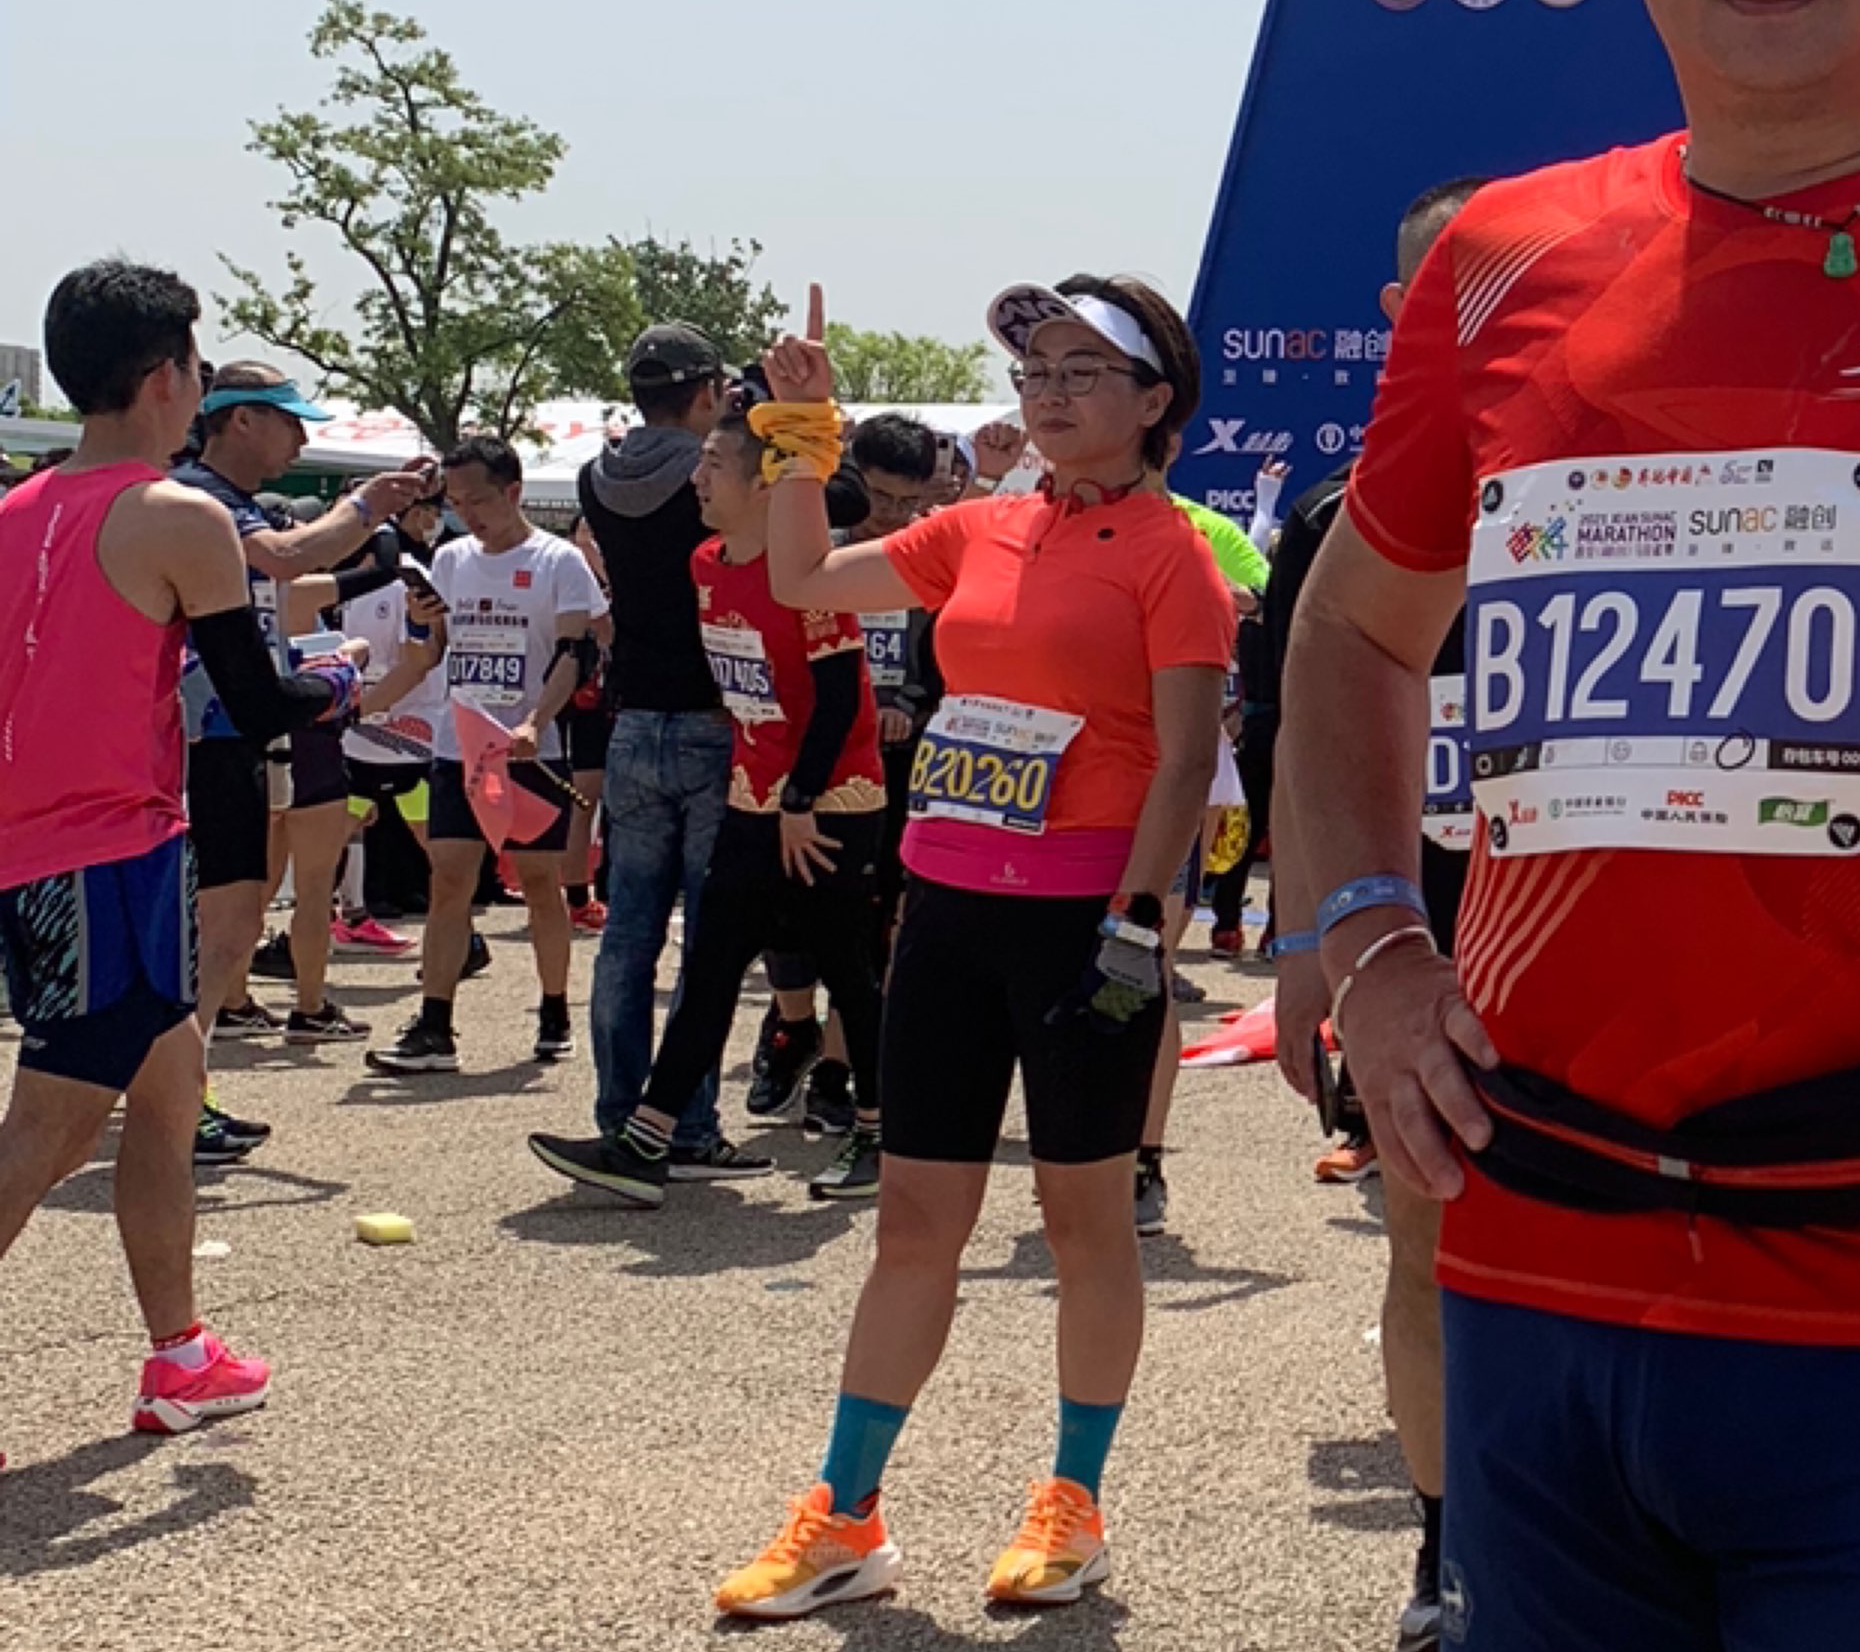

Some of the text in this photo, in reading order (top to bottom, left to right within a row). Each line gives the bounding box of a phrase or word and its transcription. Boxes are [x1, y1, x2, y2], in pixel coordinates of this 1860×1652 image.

[1223, 327, 1327, 359] sunac
[1206, 489, 1255, 511] PICC
[1688, 506, 1777, 536] sunac
[1784, 504, 1838, 531] 融创
[1578, 525, 1678, 543] MARATHON
[864, 631, 902, 662] 64
[1475, 586, 1856, 733] B12470
[909, 737, 1048, 812] B20260
[1665, 789, 1704, 806] PICC
